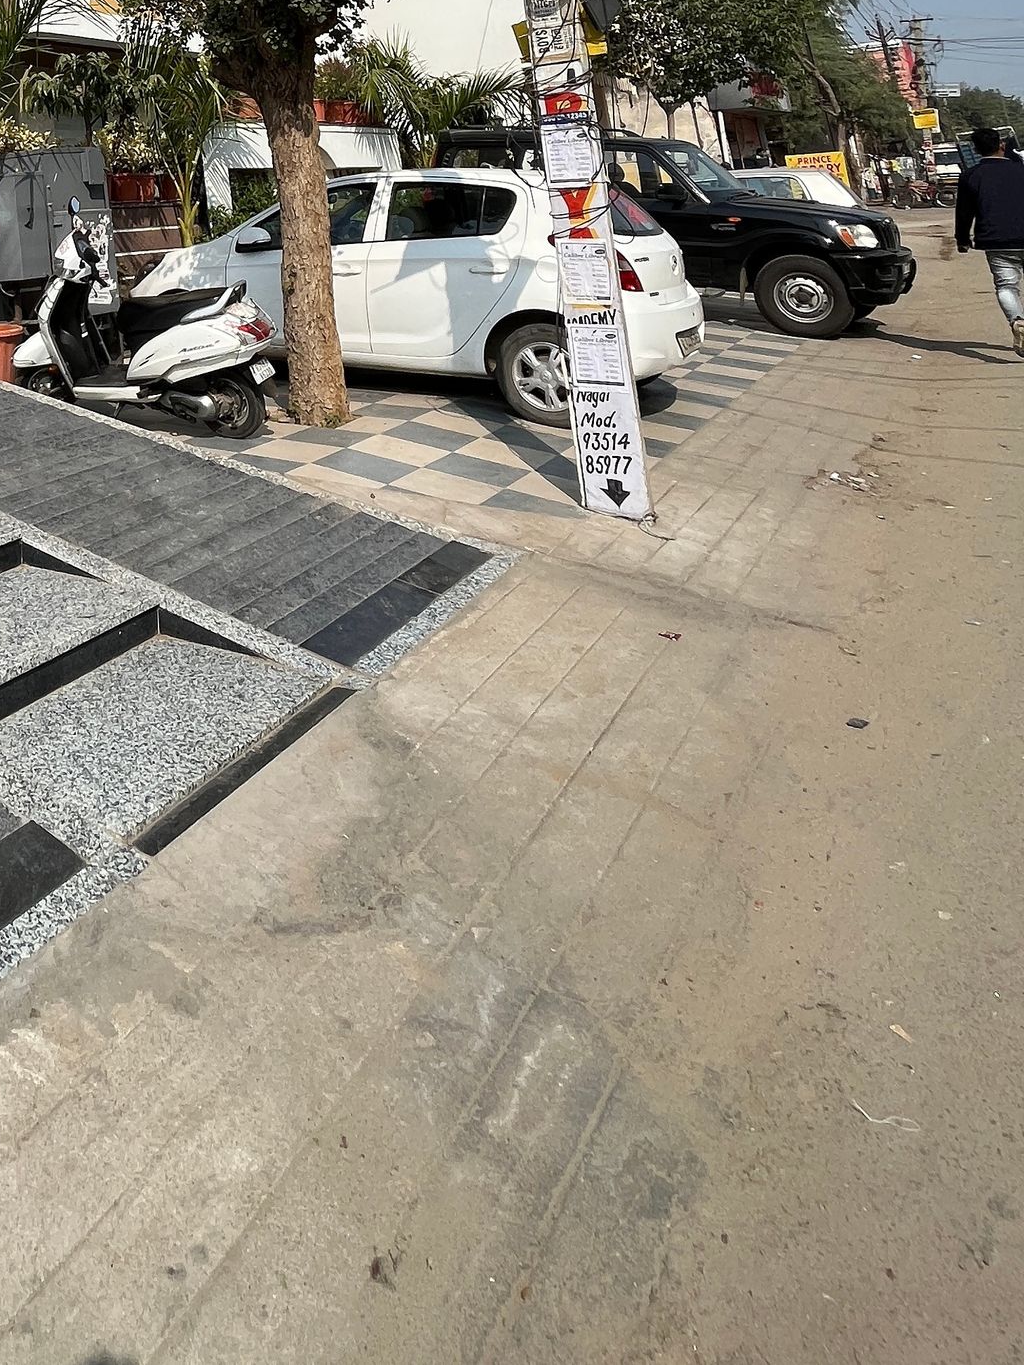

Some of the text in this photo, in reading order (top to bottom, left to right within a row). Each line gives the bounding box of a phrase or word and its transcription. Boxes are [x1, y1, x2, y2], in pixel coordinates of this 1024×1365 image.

[797, 155, 832, 165] PRINCE
[583, 432, 631, 451] 93514
[585, 455, 633, 474] 85977
